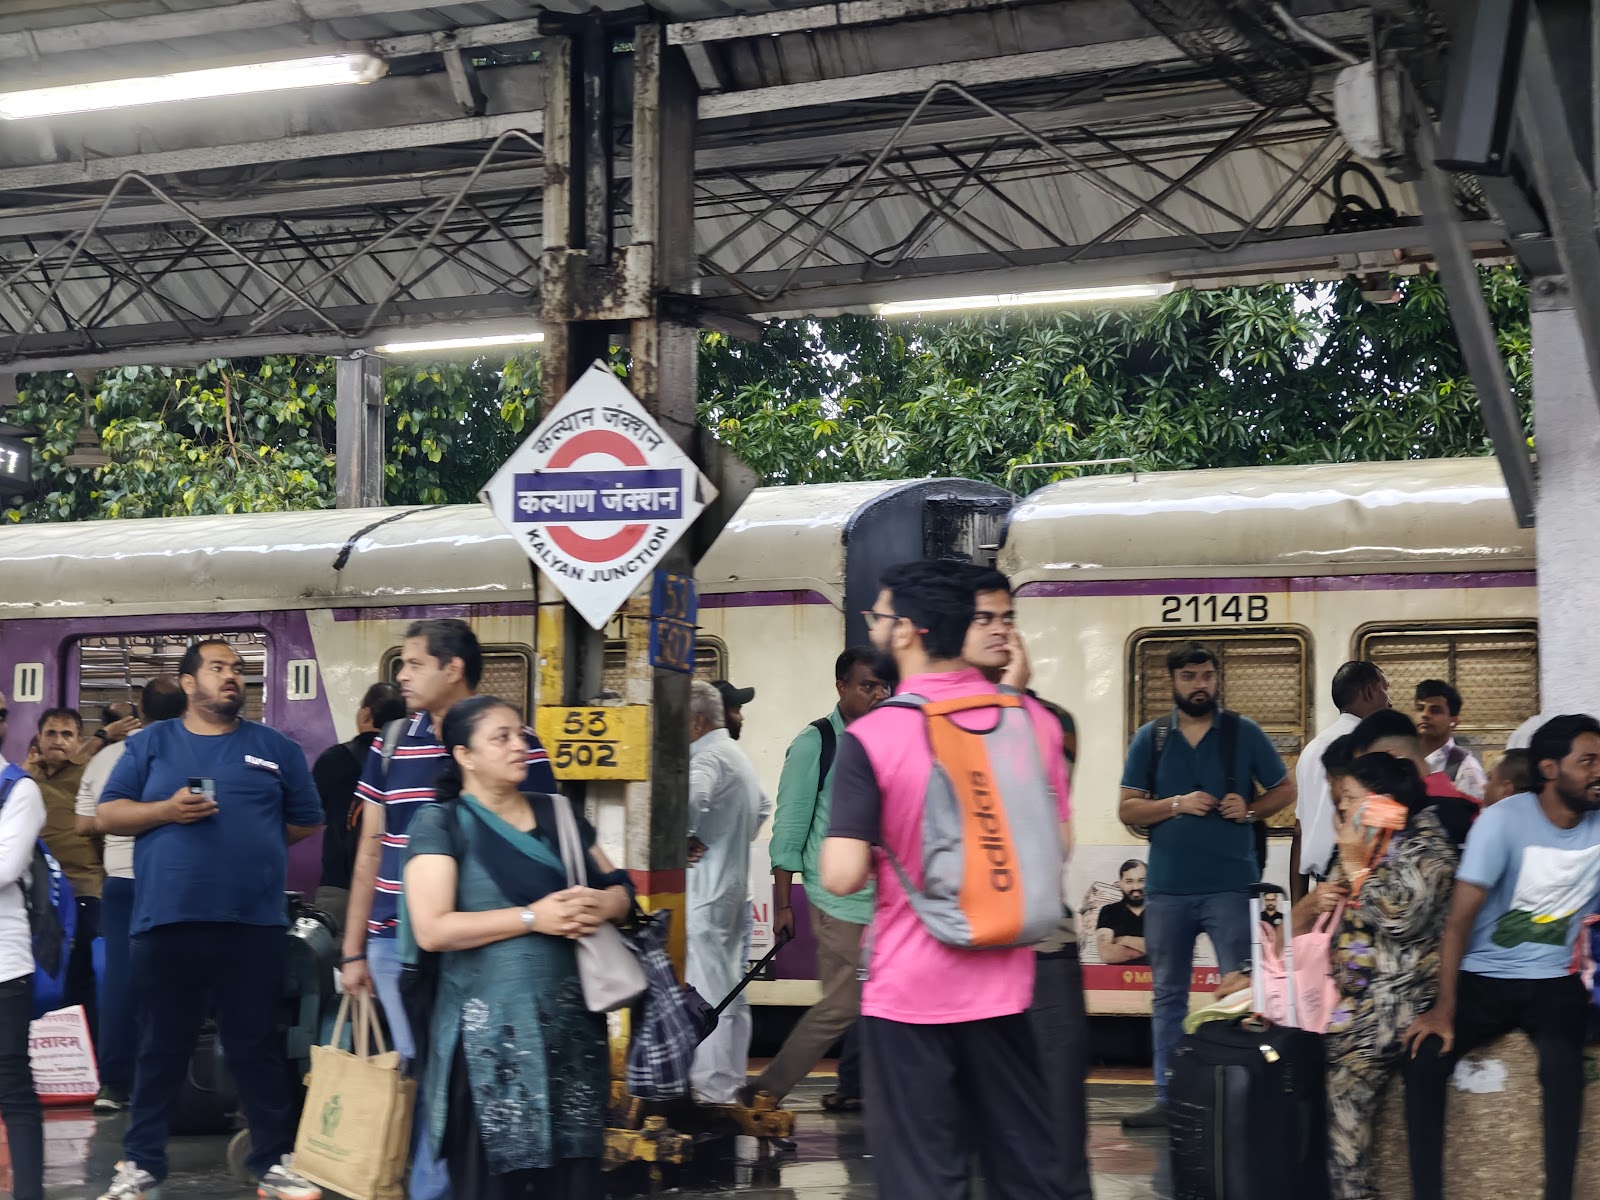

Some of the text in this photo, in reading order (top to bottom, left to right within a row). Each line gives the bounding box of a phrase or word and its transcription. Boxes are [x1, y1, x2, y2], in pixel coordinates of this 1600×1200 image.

[517, 483, 679, 514] कल्याण जंक्शन
[526, 525, 669, 582] KALYAN JUNCTION
[1162, 595, 1268, 622] 2114B
[563, 711, 607, 737] 53
[555, 743, 617, 768] 502
[968, 770, 1014, 893] adidas
